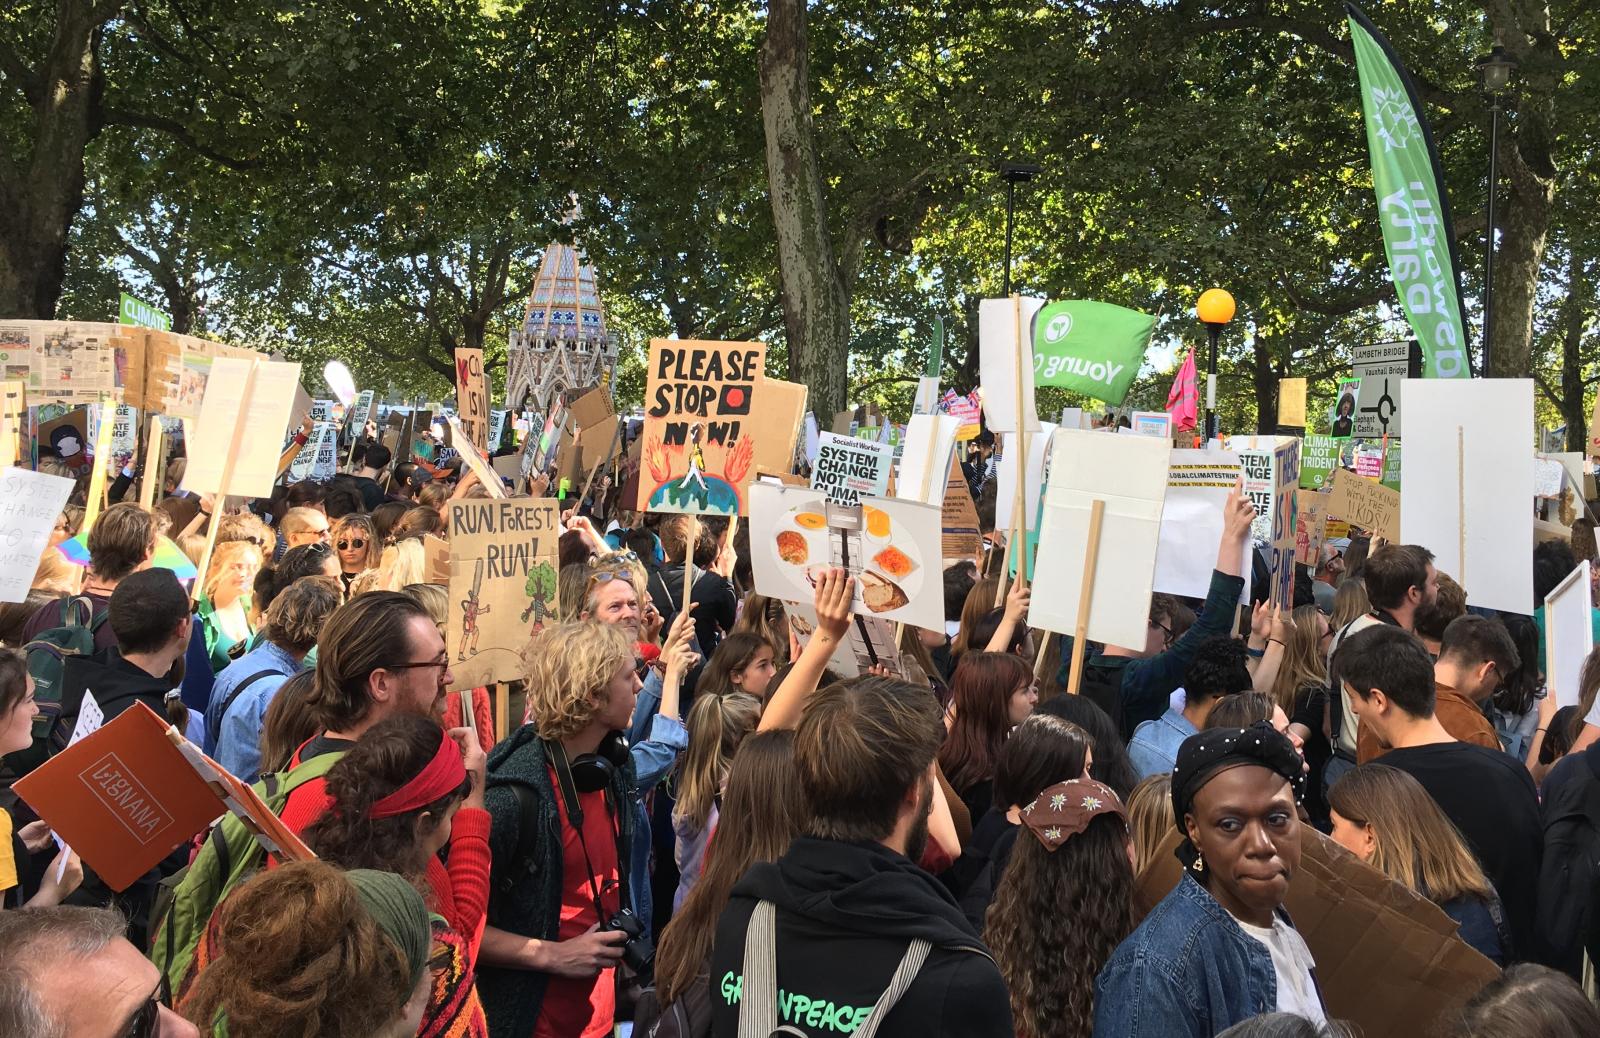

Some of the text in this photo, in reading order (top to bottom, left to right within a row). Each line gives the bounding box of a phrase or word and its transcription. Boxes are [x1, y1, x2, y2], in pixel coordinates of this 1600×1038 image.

[124, 299, 167, 331] CLIMATE
[1355, 347, 1406, 360] LAMBETH BRIDGE
[658, 349, 760, 382] PLEASE
[1365, 366, 1407, 376] Vauxhall Bridge
[648, 384, 717, 418] STOP
[1358, 424, 1374, 432] Castle
[832, 437, 880, 452] Socialist Worker
[1303, 435, 1338, 449] CLIMATE
[820, 446, 878, 468] SYSTEM
[1310, 447, 1330, 457] NOT
[818, 459, 878, 481] CHANGE
[1302, 456, 1337, 470] TRIDENT
[816, 470, 846, 486] NOT
[1343, 474, 1362, 489] STOP
[452, 503, 497, 536] RUN,
[488, 537, 539, 580] RUN!
